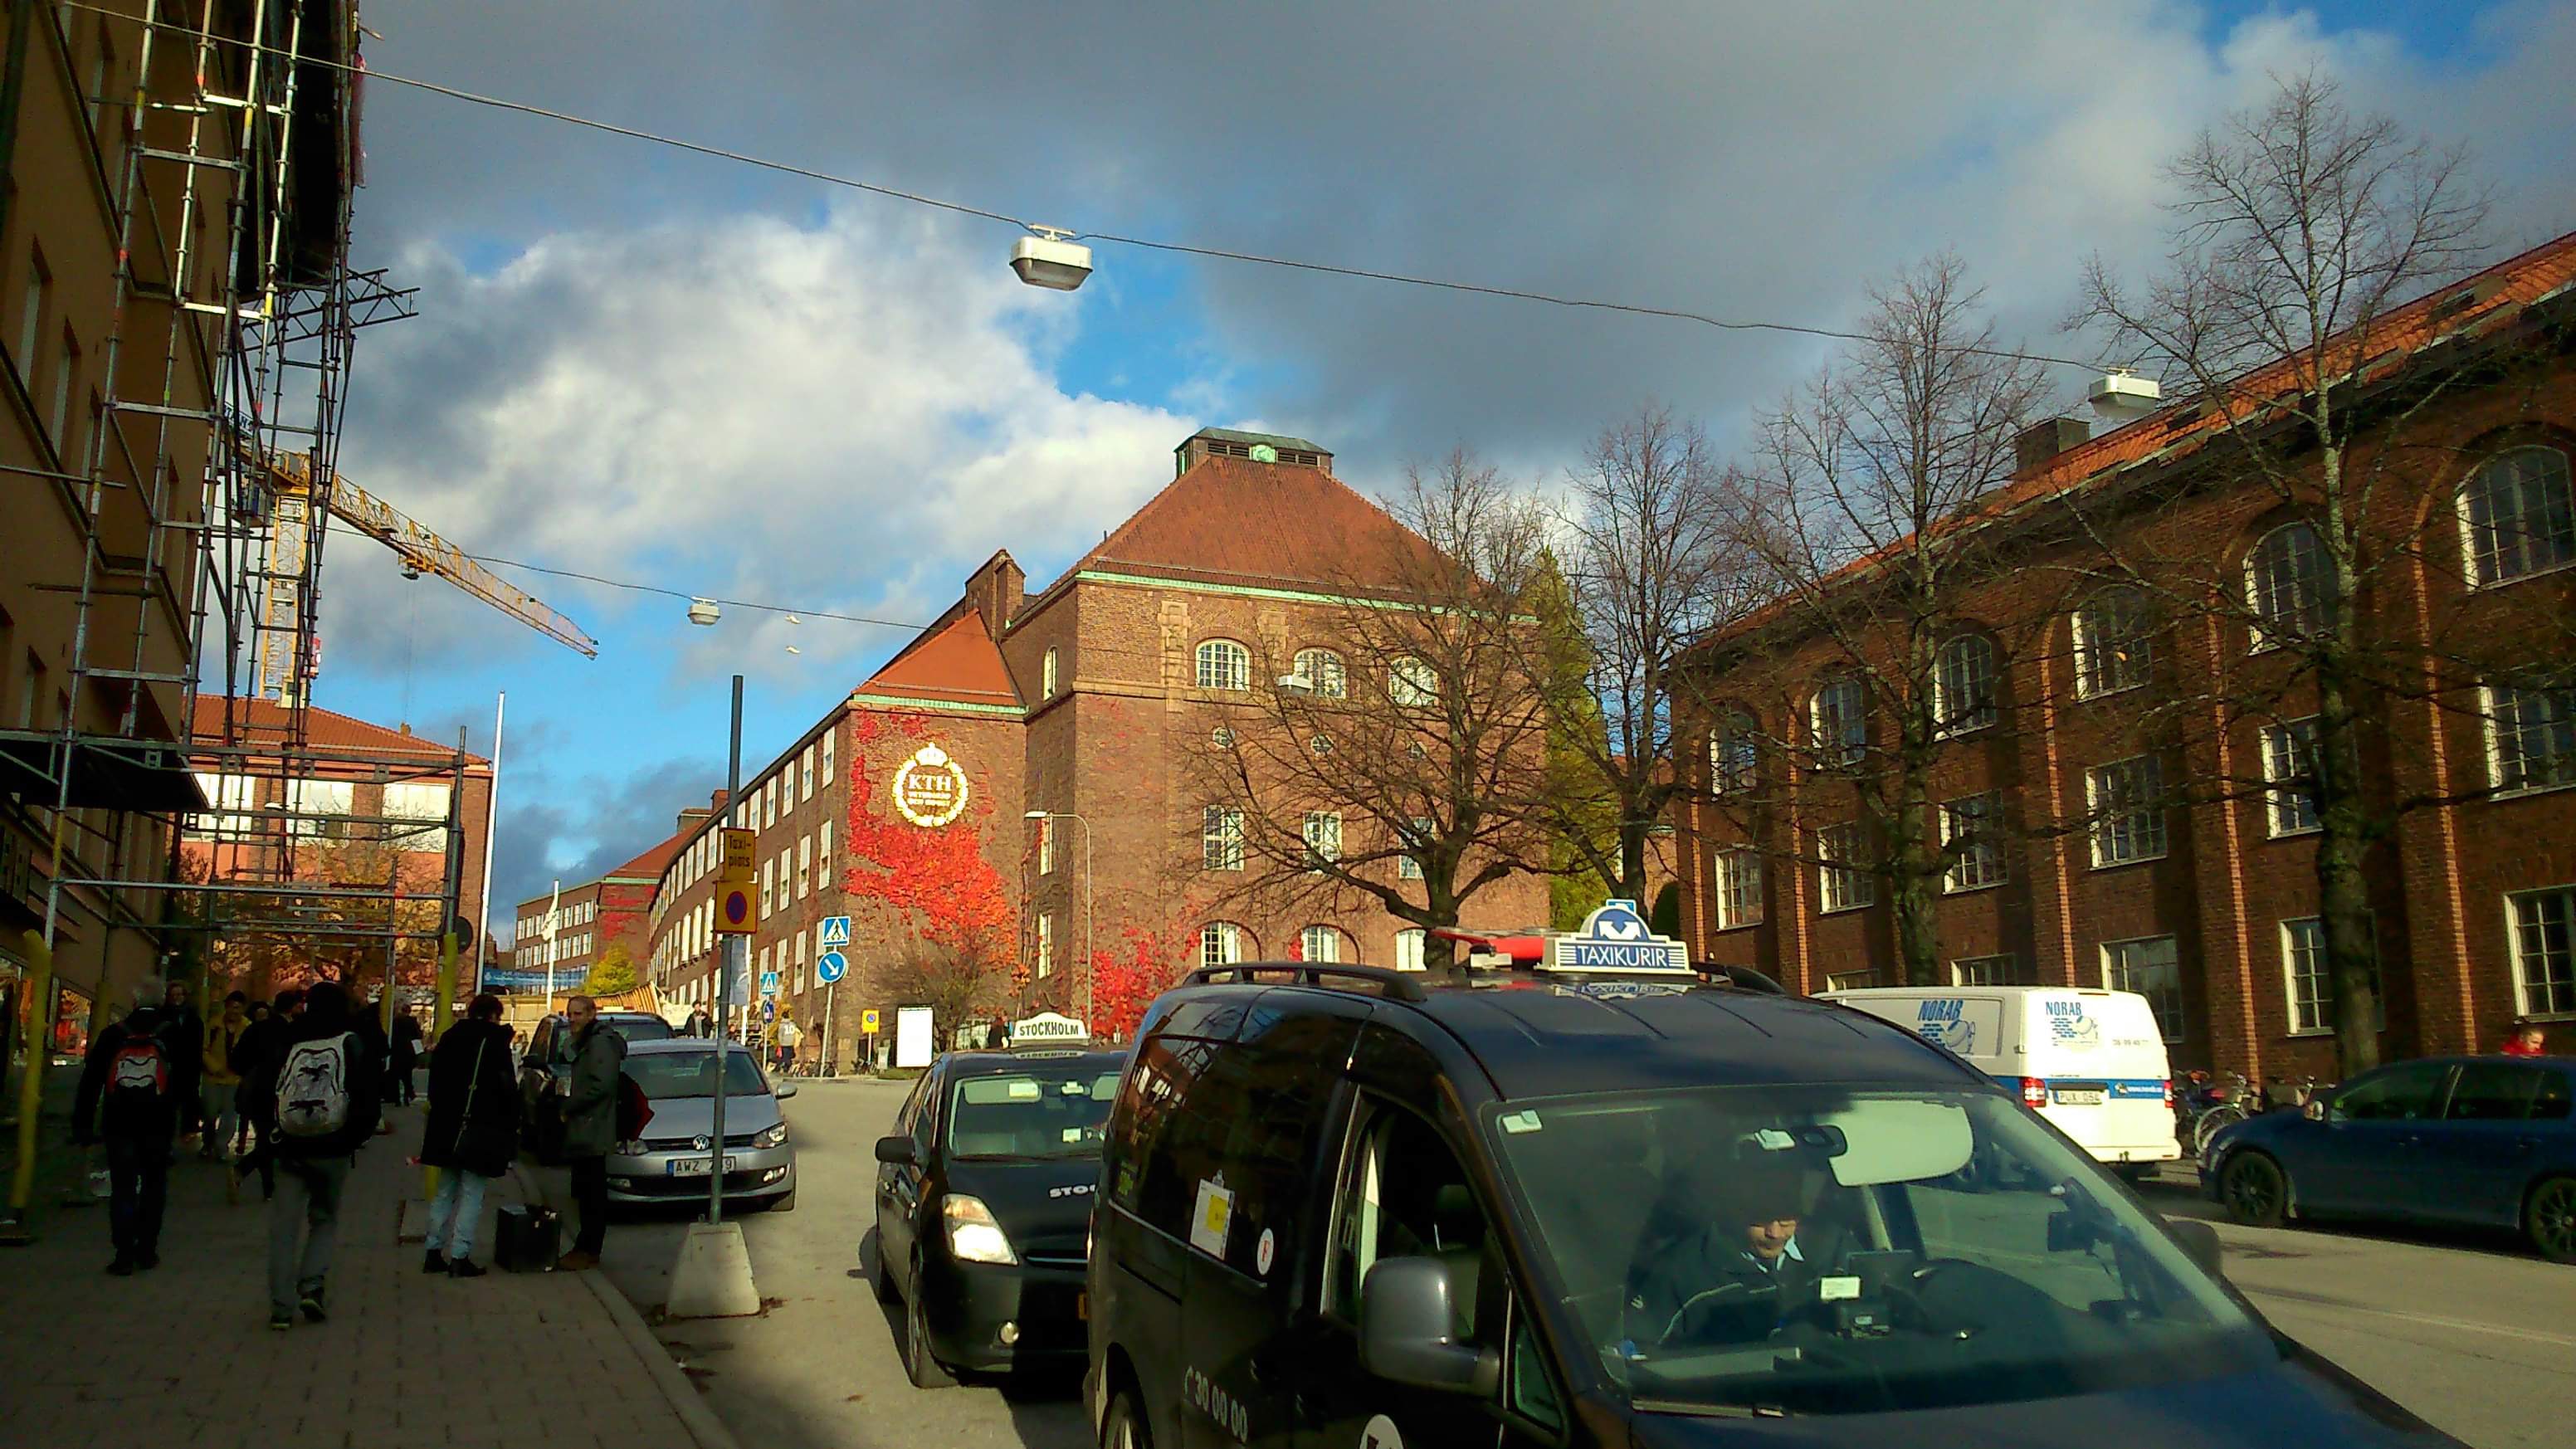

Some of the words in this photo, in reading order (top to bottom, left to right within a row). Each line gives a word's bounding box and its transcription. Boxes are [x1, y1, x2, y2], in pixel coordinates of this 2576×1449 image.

[908, 773, 952, 792] KTH
[728, 835, 752, 850] Taxi-
[1578, 945, 1667, 968] TAXIKURIR
[1917, 999, 1964, 1022] NORAB
[2045, 1001, 2082, 1017] NORAB
[1019, 1021, 1079, 1037] STOCKHOLM
[676, 1160, 700, 1172] AWZ
[709, 1158, 732, 1170] 79
[1195, 1369, 1210, 1412] 30
[1212, 1384, 1228, 1427] 00
[1230, 1398, 1249, 1443] 00
